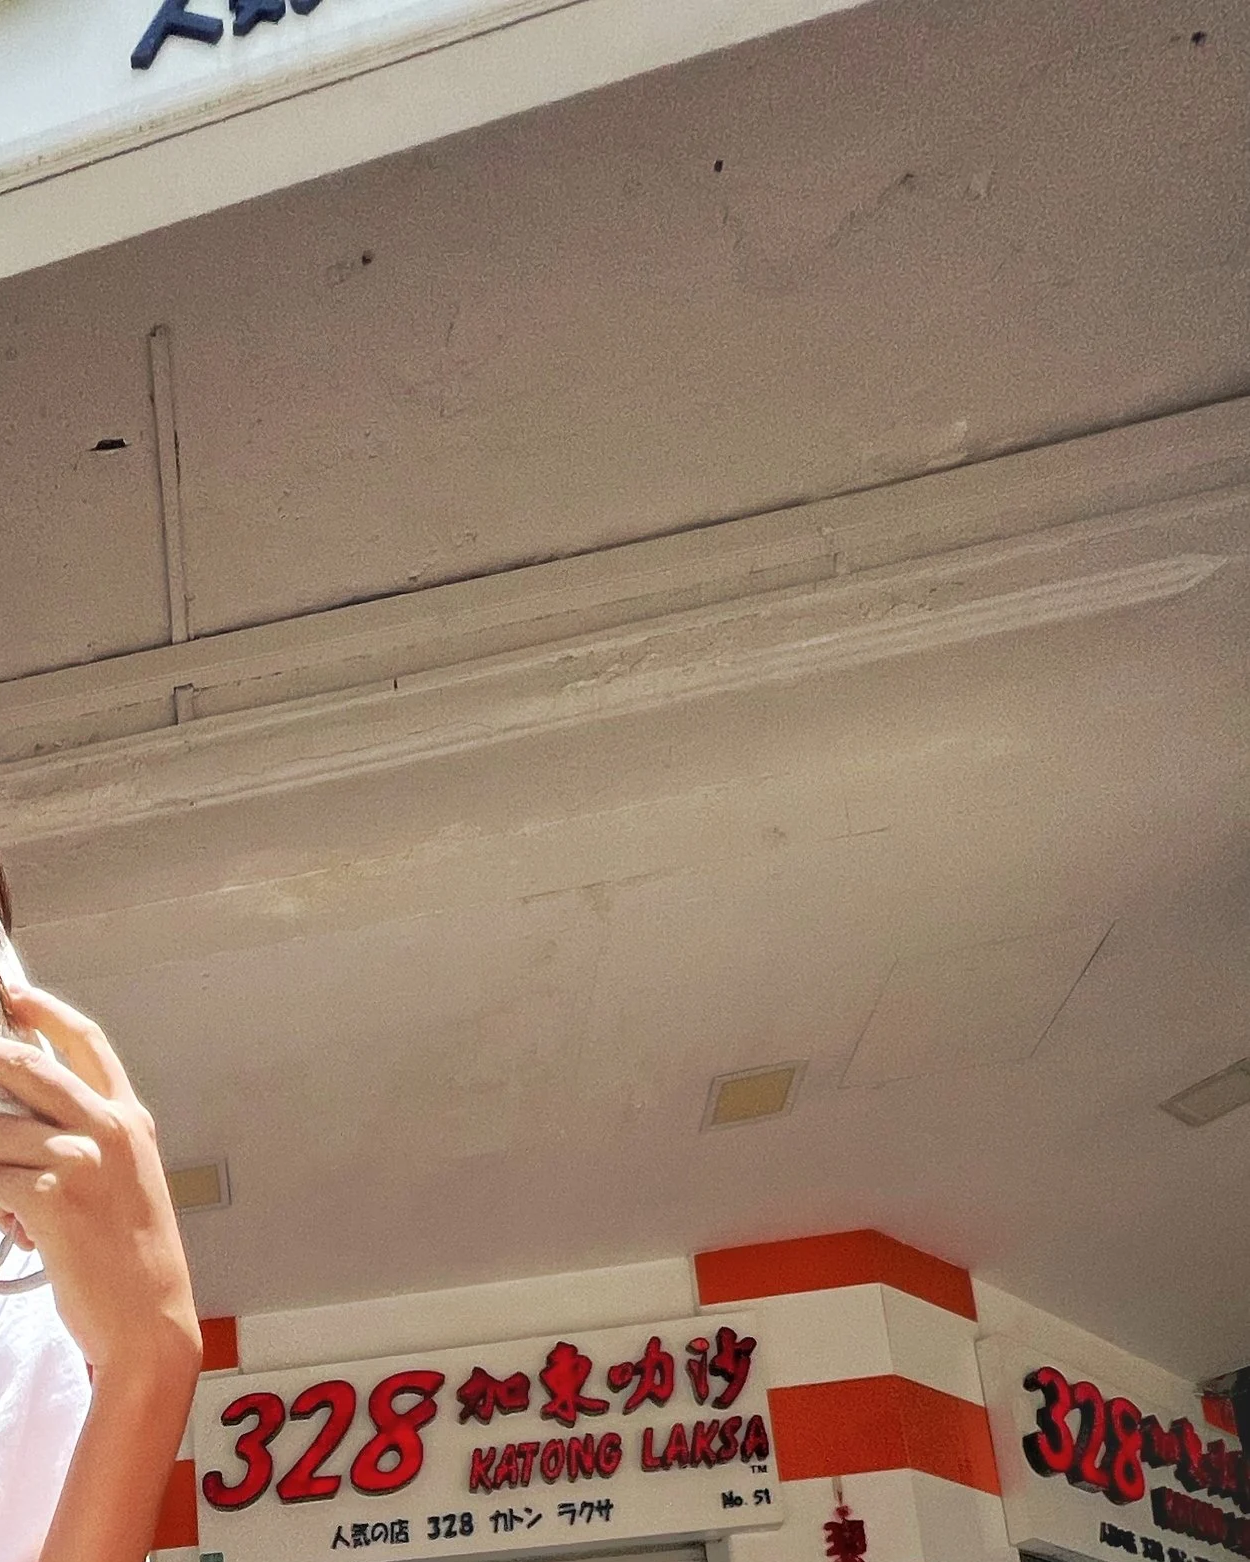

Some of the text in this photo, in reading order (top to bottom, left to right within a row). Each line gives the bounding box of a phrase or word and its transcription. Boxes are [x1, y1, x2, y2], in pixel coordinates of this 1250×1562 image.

[203, 1370, 445, 1512] 328
[469, 1415, 770, 1494] KATONG LAKSA
[1022, 1366, 1145, 1506] 328
[330, 1499, 614, 1550] 人気の店 328 カトン ラクサ
[721, 1488, 772, 1510] No. 51
